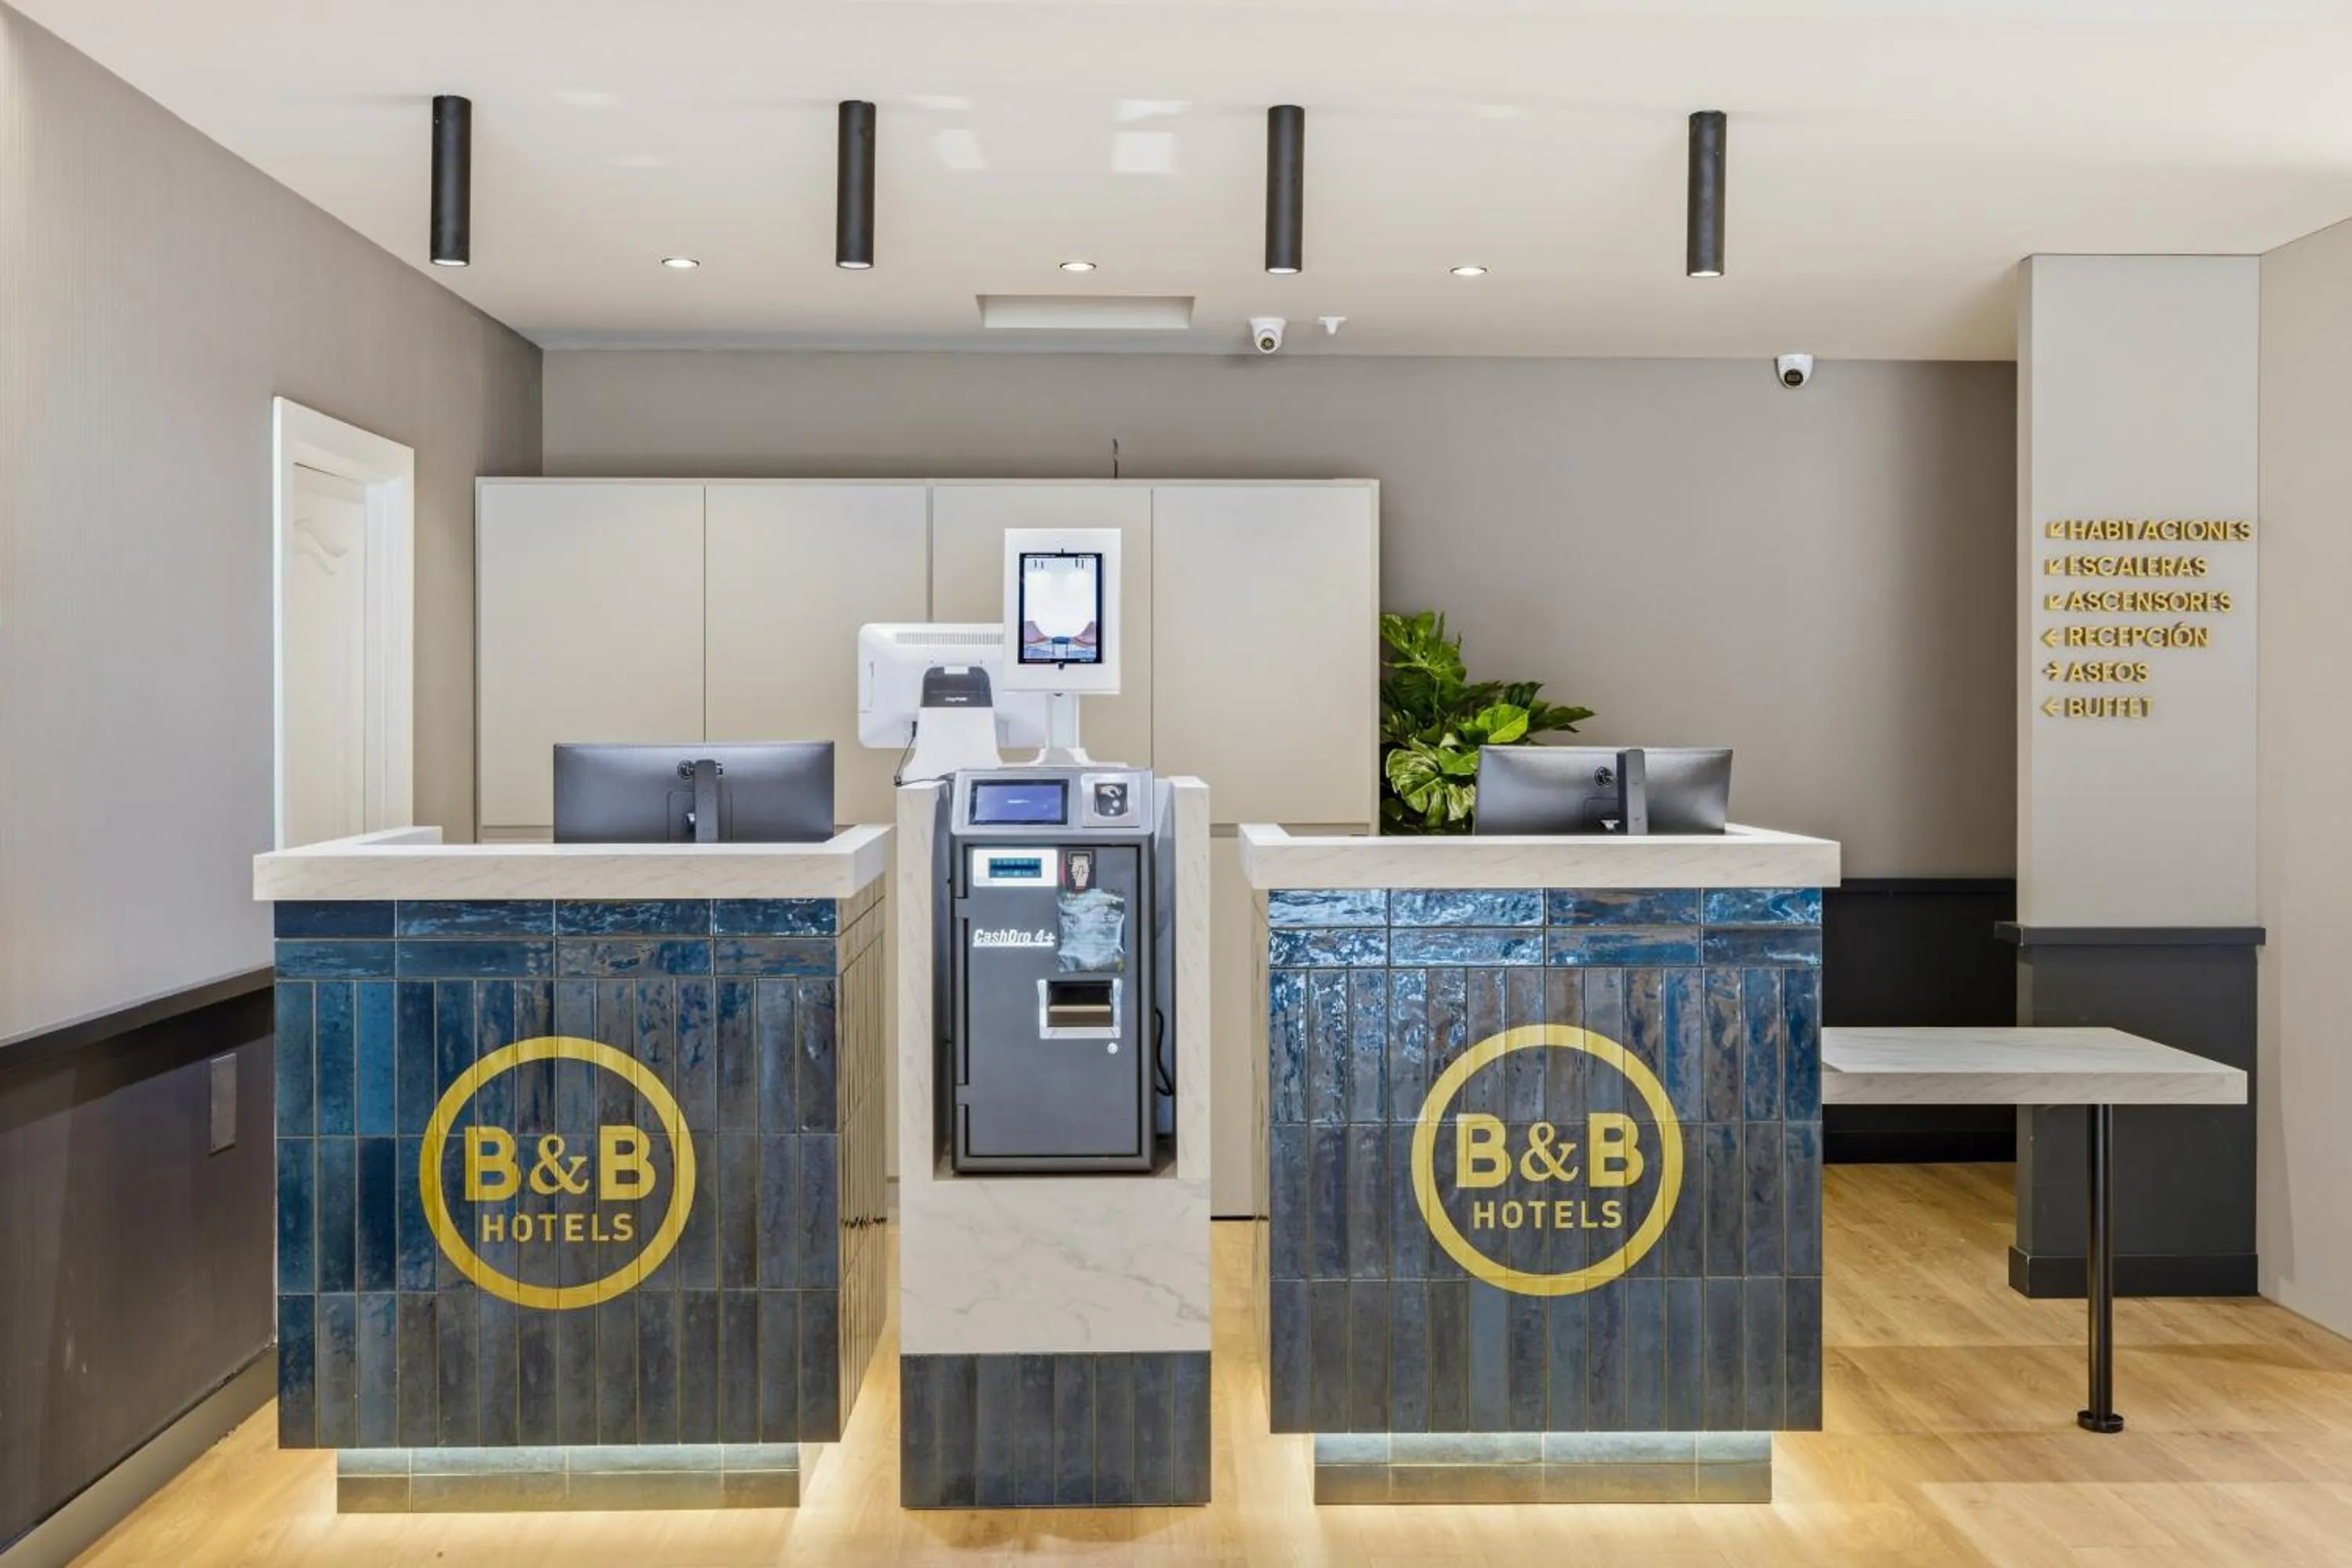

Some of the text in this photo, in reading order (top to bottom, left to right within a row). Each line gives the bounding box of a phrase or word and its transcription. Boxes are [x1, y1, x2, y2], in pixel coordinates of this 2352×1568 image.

[2065, 520, 2252, 540] HABITACIONES
[2065, 555, 2209, 576] ESCALERAS
[2065, 591, 2233, 612] ASCENSORES
[2065, 621, 2209, 648] RECEPCIÓN
[2064, 662, 2150, 683] ASEOS
[2064, 698, 2154, 718] BUFFET
[973, 928, 1055, 943] CashDro 4+
[1456, 1112, 1644, 1188] B&B
[465, 1125, 656, 1201] B&B
[1472, 1200, 1623, 1229] HOTELS
[481, 1213, 635, 1243] HOTELS
